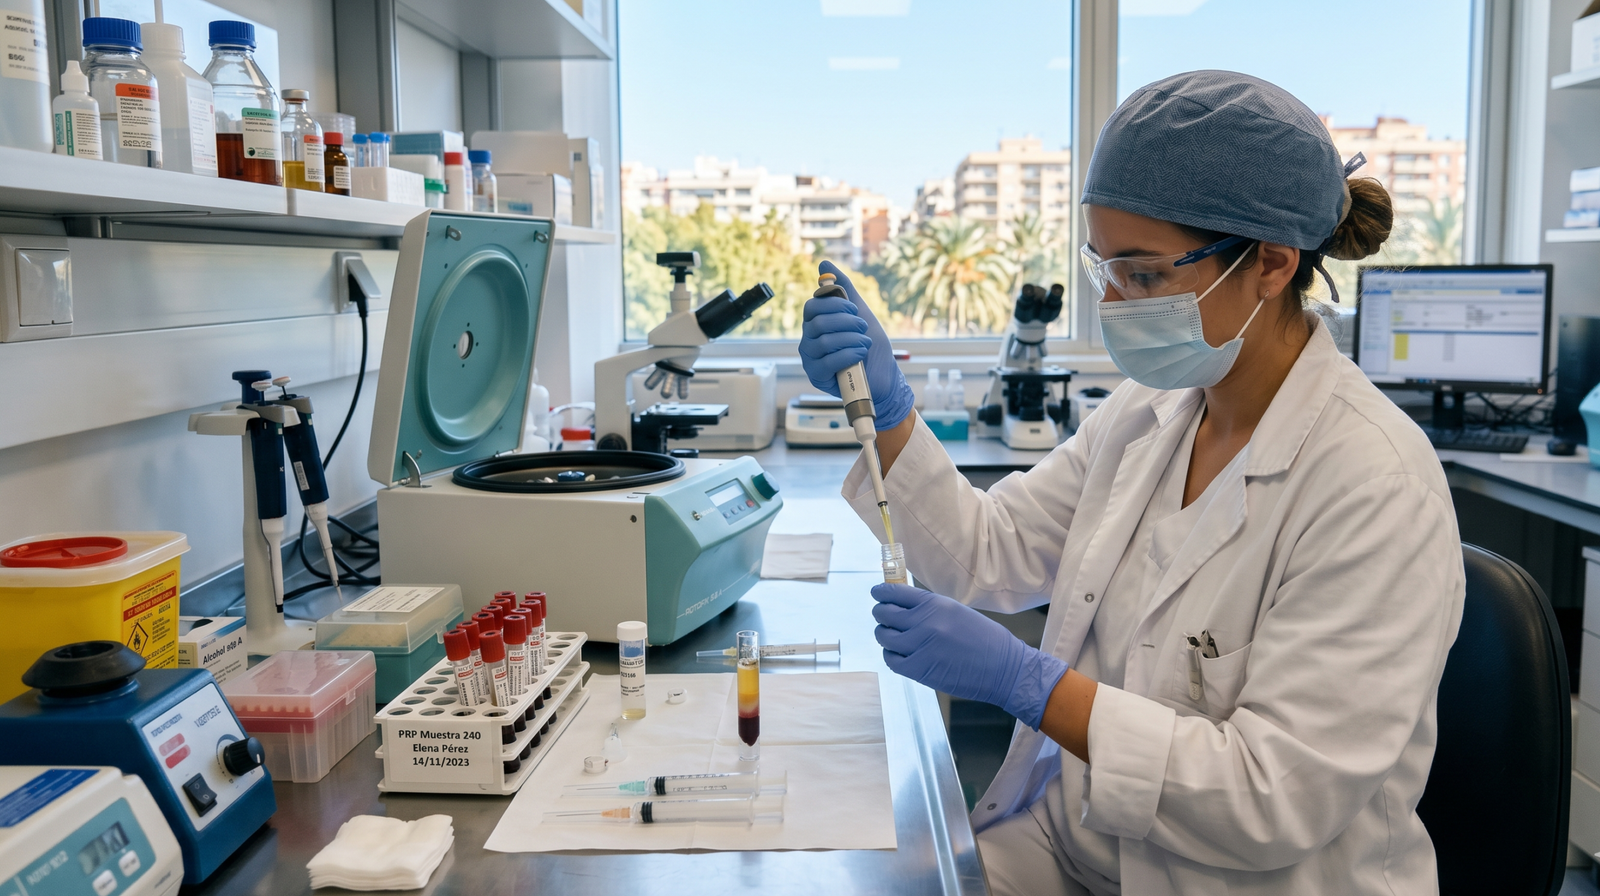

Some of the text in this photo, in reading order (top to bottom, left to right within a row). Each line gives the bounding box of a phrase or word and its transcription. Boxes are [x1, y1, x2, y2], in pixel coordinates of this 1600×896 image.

[202, 645, 225, 665] Alcohol
[237, 636, 243, 646] A
[398, 730, 481, 740] PRP Muestra 240
[412, 743, 469, 753] Elena Pérez
[412, 757, 470, 767] 14/11/2023
